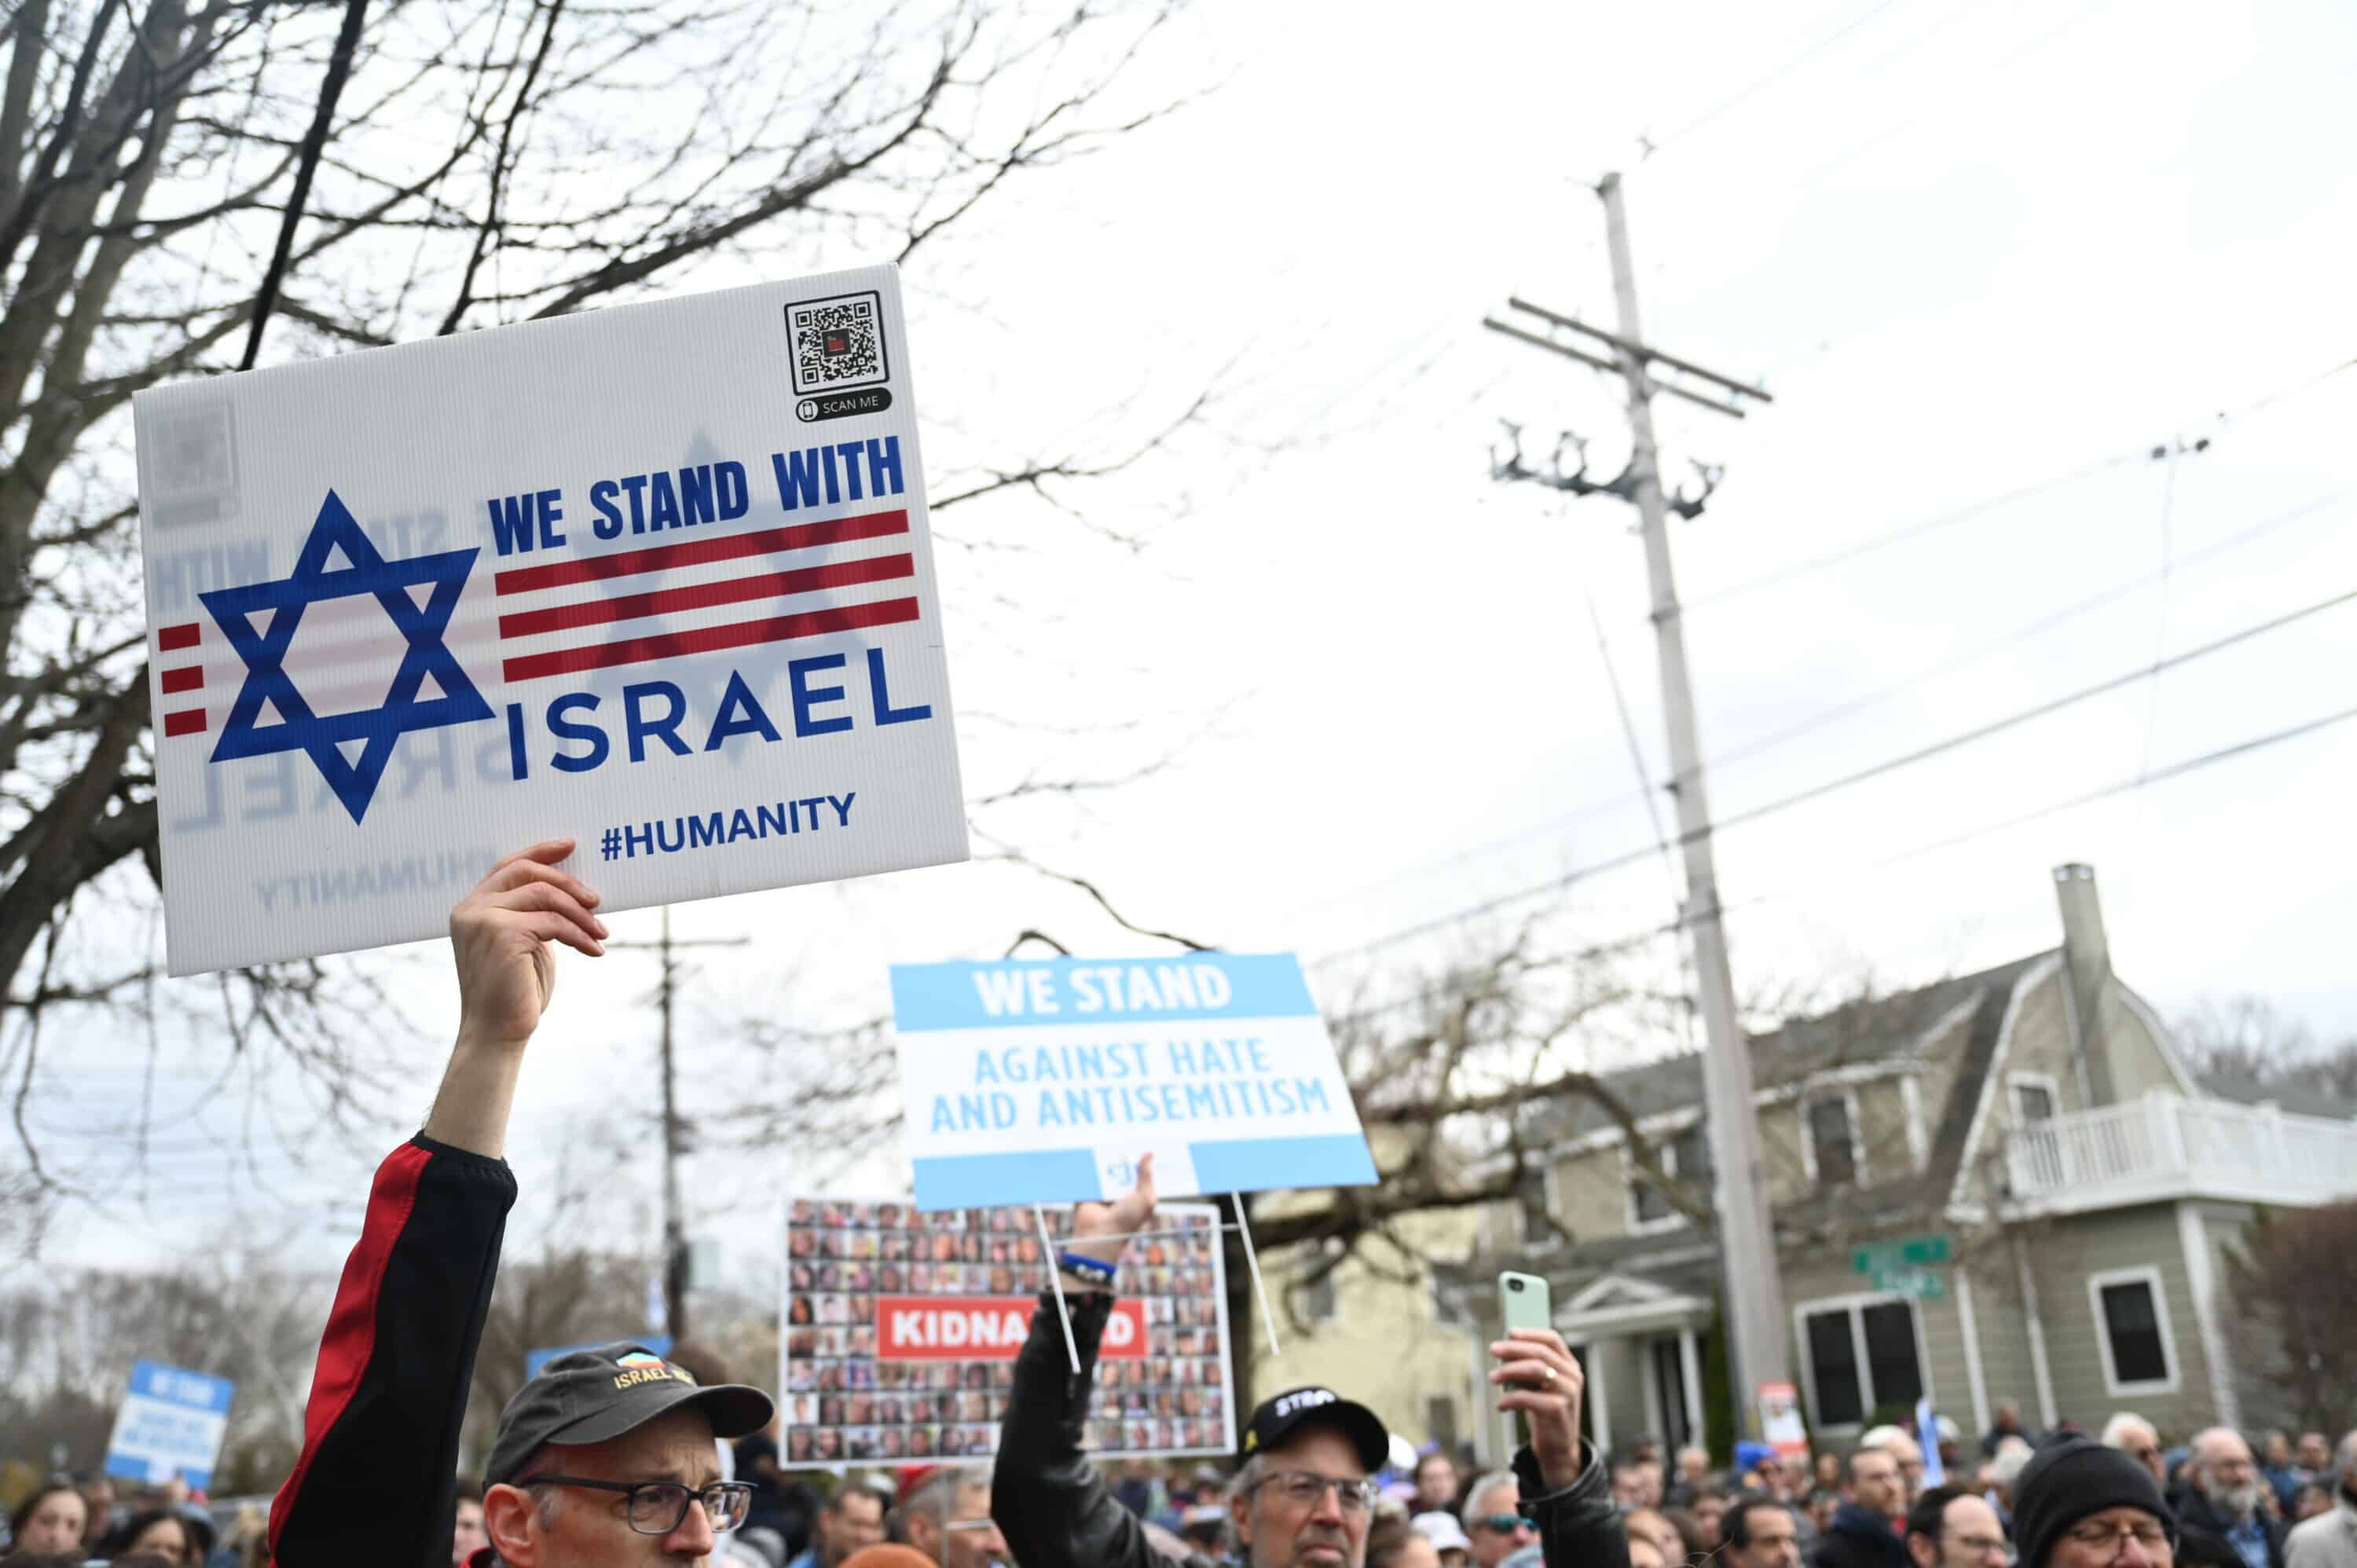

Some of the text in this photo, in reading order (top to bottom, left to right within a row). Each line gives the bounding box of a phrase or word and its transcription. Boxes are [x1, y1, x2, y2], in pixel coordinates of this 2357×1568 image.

[823, 395, 879, 414] SCAN ME
[489, 489, 566, 556] WE
[590, 460, 750, 540] STAND
[772, 435, 904, 511] WITH
[507, 647, 932, 780] ISRAEL
[601, 792, 856, 861] #HUMANITY
[973, 963, 1233, 1016] WE STAND
[974, 1038, 1271, 1084] AGAINST HATE
[931, 1078, 1330, 1133] AND ANTISEMITISM
[891, 1310, 1135, 1346] KIDNAD
[614, 1368, 673, 1390] ISRAEL
